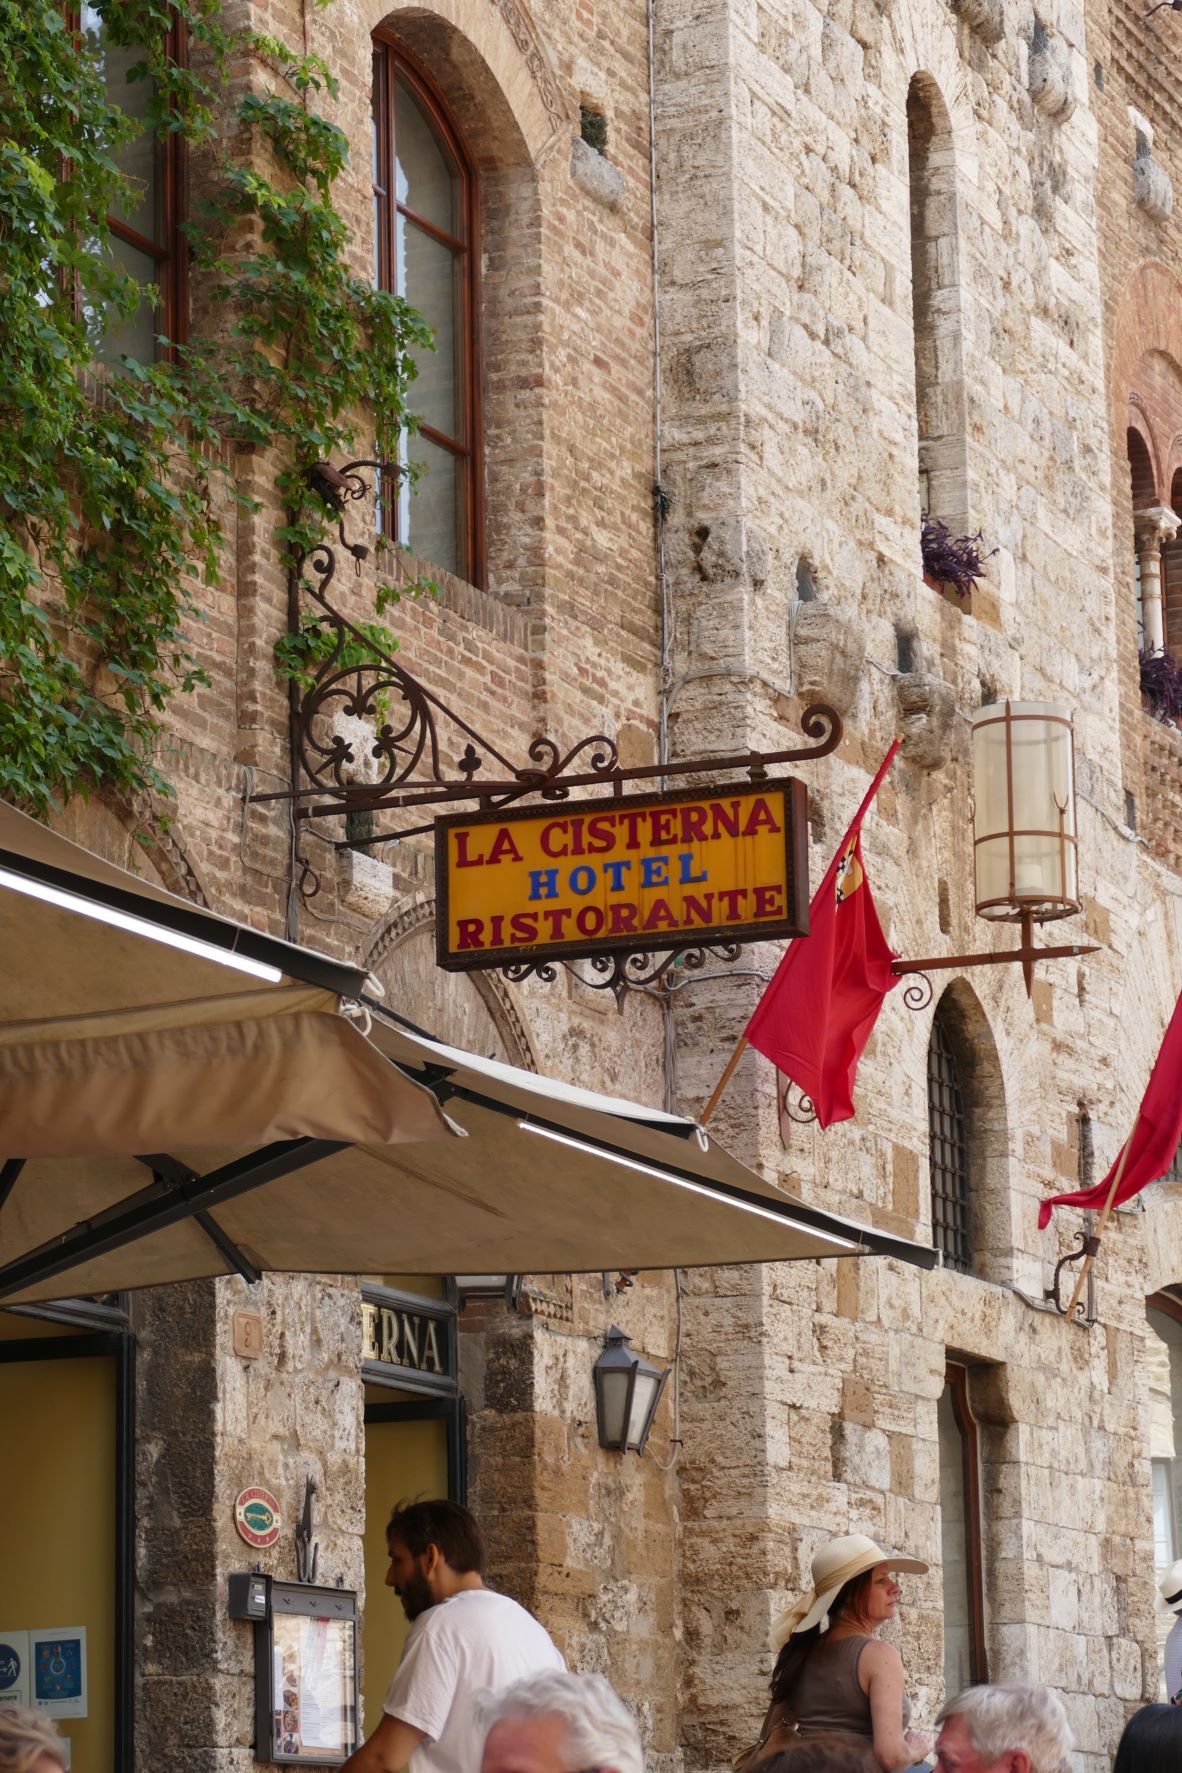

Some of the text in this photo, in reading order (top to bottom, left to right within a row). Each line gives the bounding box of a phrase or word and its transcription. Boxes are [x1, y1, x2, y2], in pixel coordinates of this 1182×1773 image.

[454, 798, 781, 868] LA CISTERNA
[528, 853, 708, 901] HOTEL
[457, 885, 783, 950] RISTORANTE
